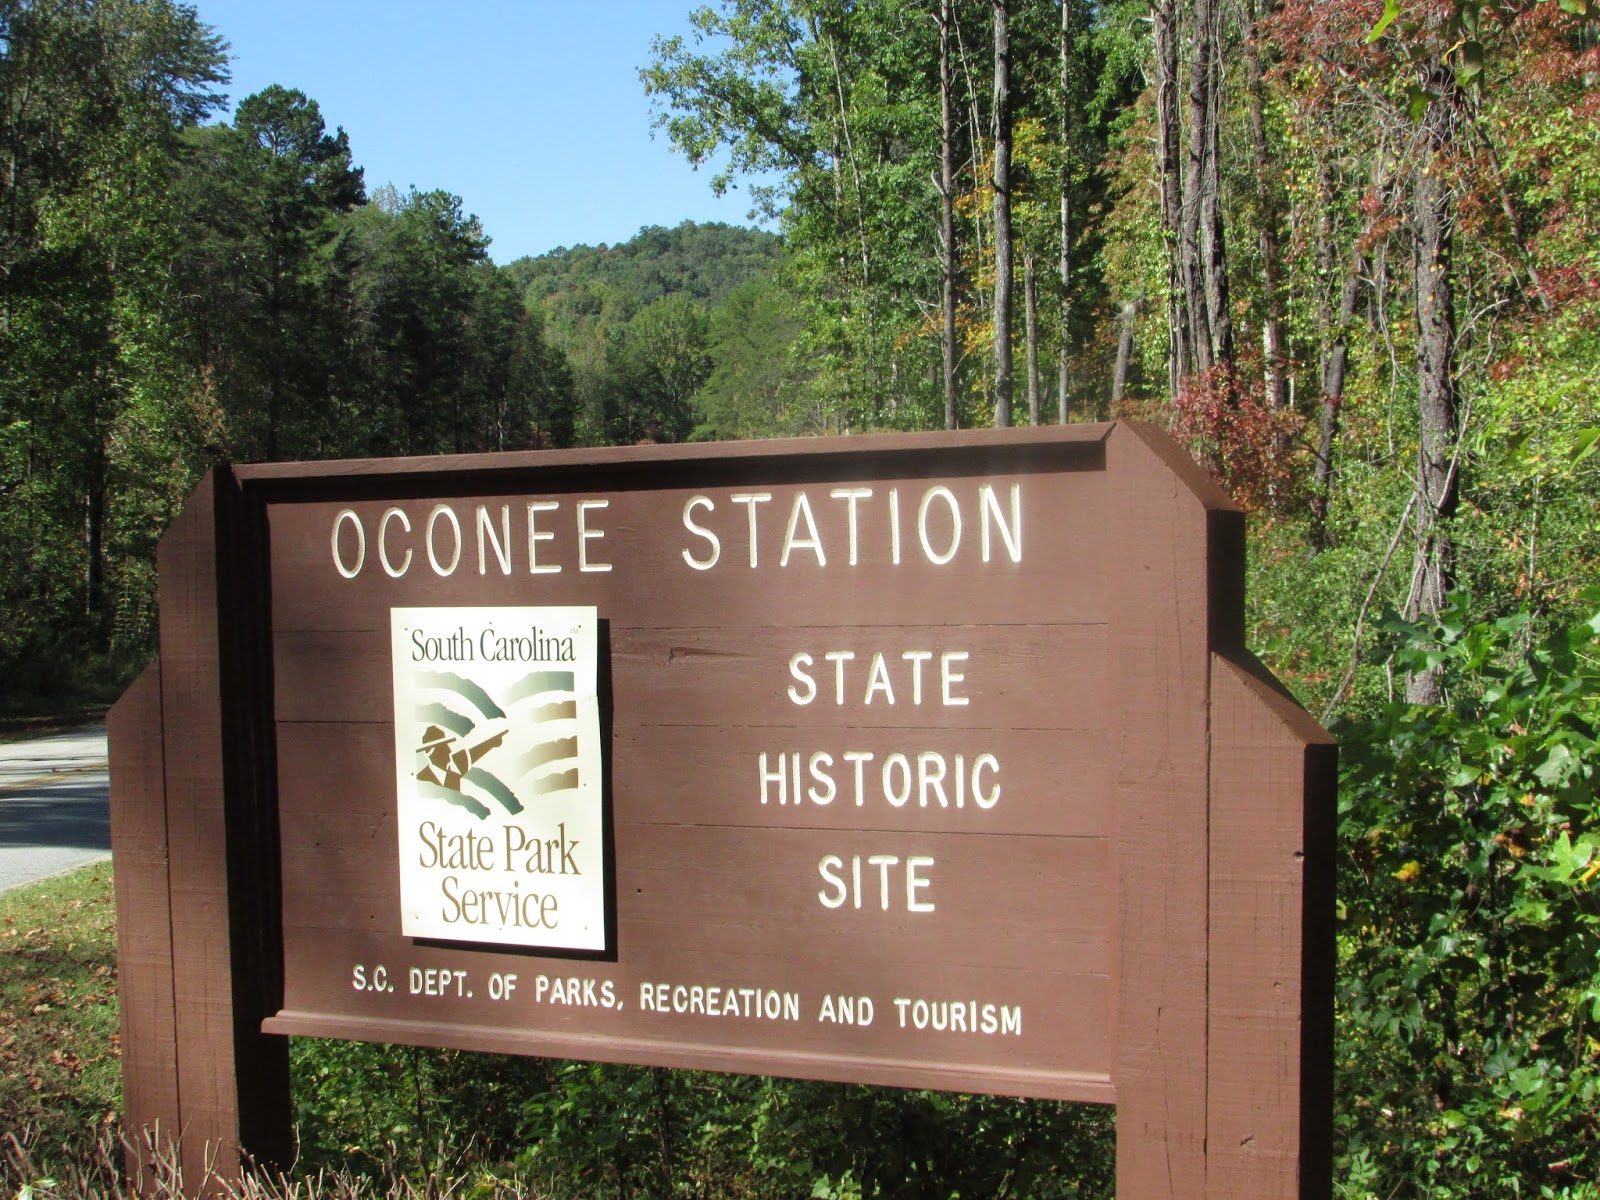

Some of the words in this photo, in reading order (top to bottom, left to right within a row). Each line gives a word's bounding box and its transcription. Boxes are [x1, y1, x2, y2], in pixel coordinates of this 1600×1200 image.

[332, 500, 612, 579] OCONEE
[681, 483, 1023, 570] STATION
[412, 626, 474, 661] South
[480, 626, 576, 661] Carolina
[787, 650, 970, 706] STATE
[758, 751, 1001, 809] HISTORIC
[420, 822, 494, 870] State
[503, 823, 581, 875] Park
[442, 877, 558, 929] Service
[818, 855, 935, 912] SITE
[352, 965, 394, 993] S.C.
[409, 968, 474, 998] DEPT.
[488, 973, 518, 1001] OF
[535, 974, 624, 1011] PARKS,
[639, 982, 800, 1021] RECREATION
[818, 994, 875, 1026] AND
[893, 998, 1022, 1036] TOURISM
